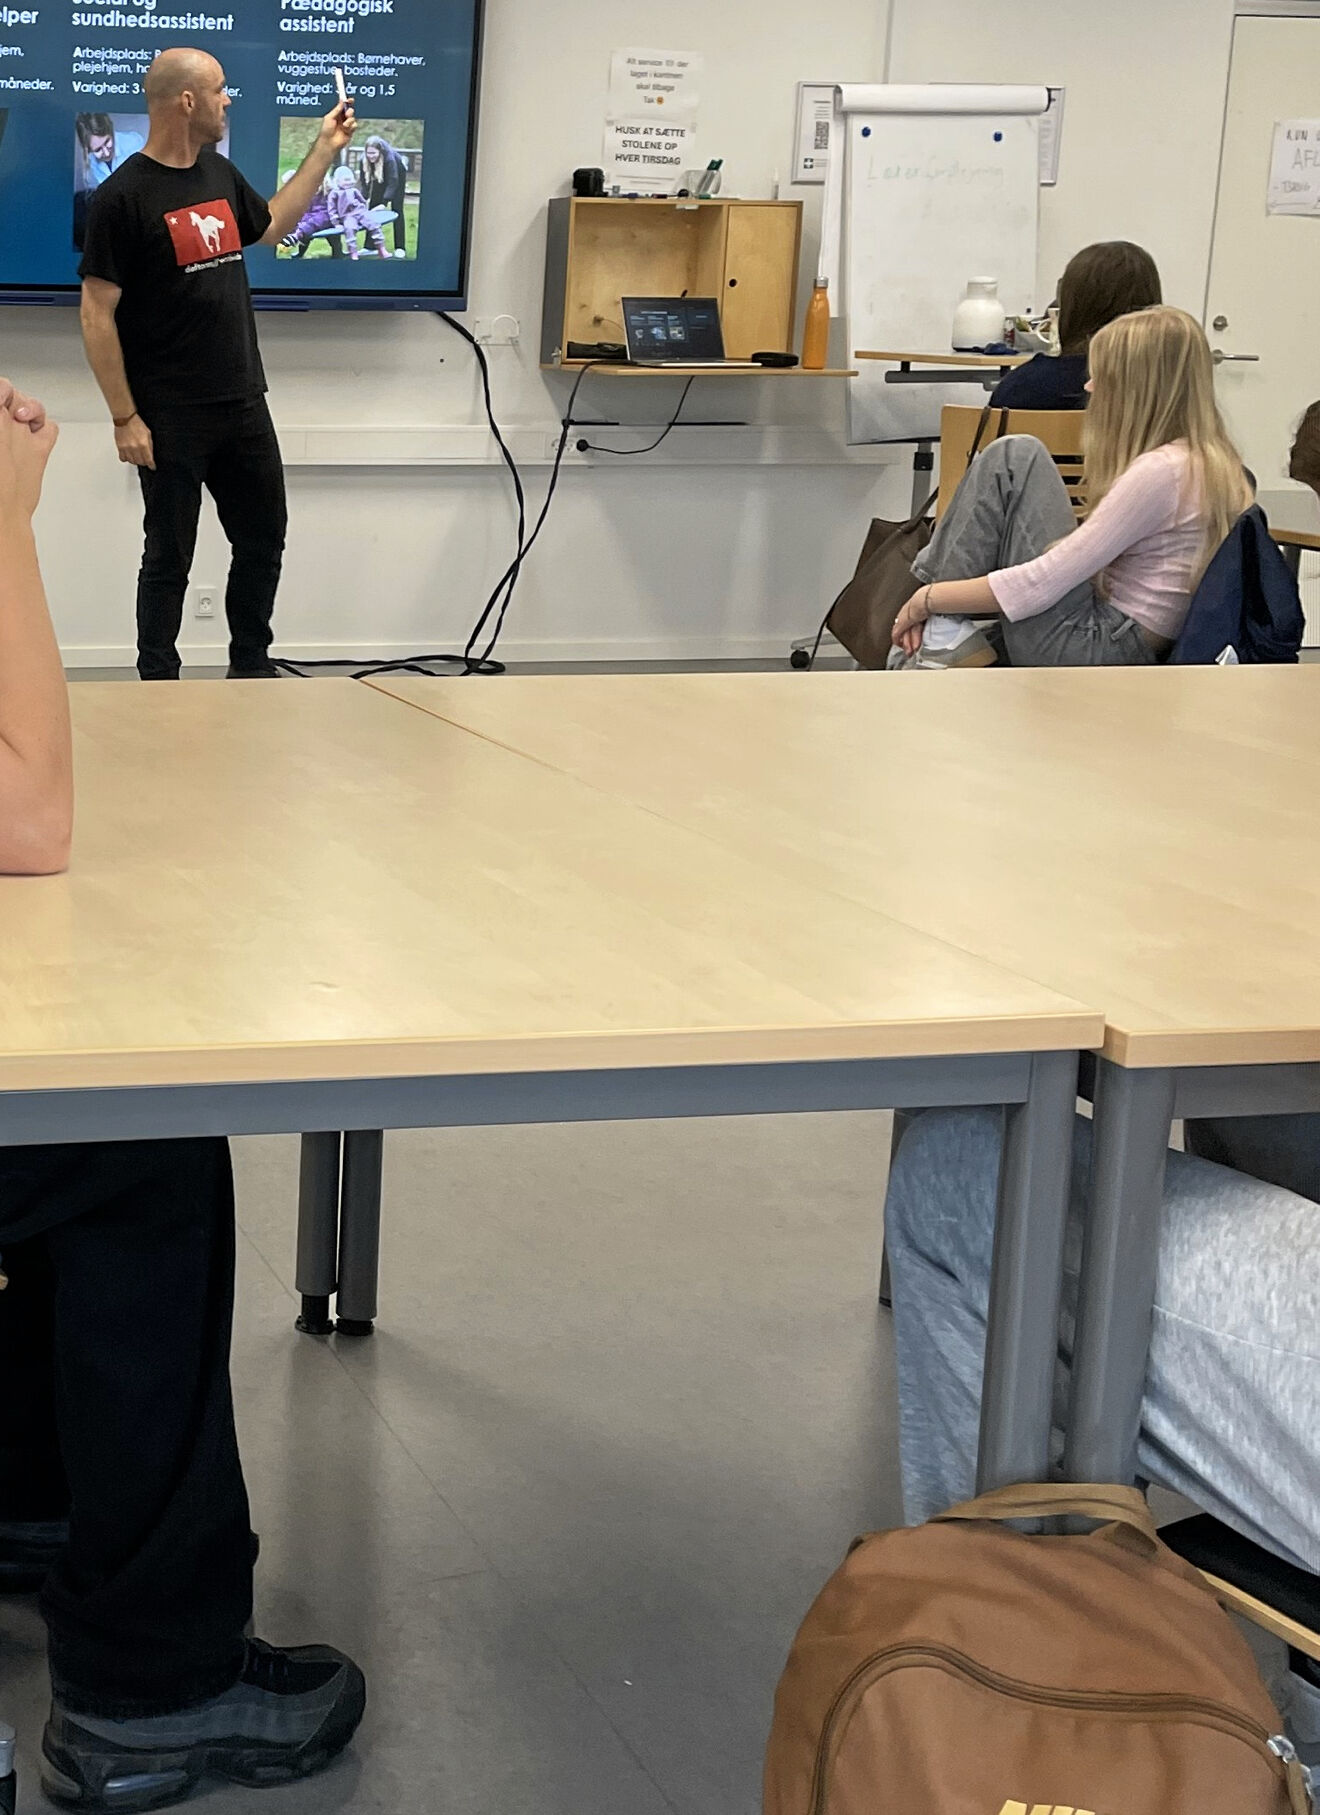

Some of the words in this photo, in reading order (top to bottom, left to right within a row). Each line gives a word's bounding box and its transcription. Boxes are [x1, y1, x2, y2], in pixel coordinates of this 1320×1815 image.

[72, 10, 234, 31] sundhedsassistent
[279, 15, 355, 33] assistent
[73, 46, 152, 62] Arbejdsplads:
[278, 50, 356, 65] Arbejdsplads:
[72, 61, 133, 75] plejehjem,
[277, 62, 338, 77] vuggestue
[344, 64, 399, 77] bosteder.
[72, 81, 130, 96] Varighed:
[132, 82, 140, 93] 3
[276, 81, 333, 96] Varighed:
[346, 82, 358, 95] år
[359, 85, 377, 98] og
[276, 93, 322, 106] måned.
[615, 126, 641, 135] HUSK
[643, 127, 653, 136] AT
[655, 128, 686, 138] SÆTTE
[622, 140, 662, 150] STOLENE
[664, 142, 678, 151] OP
[615, 153, 640, 163] HVER
[642, 155, 681, 166] TIRSDAG
